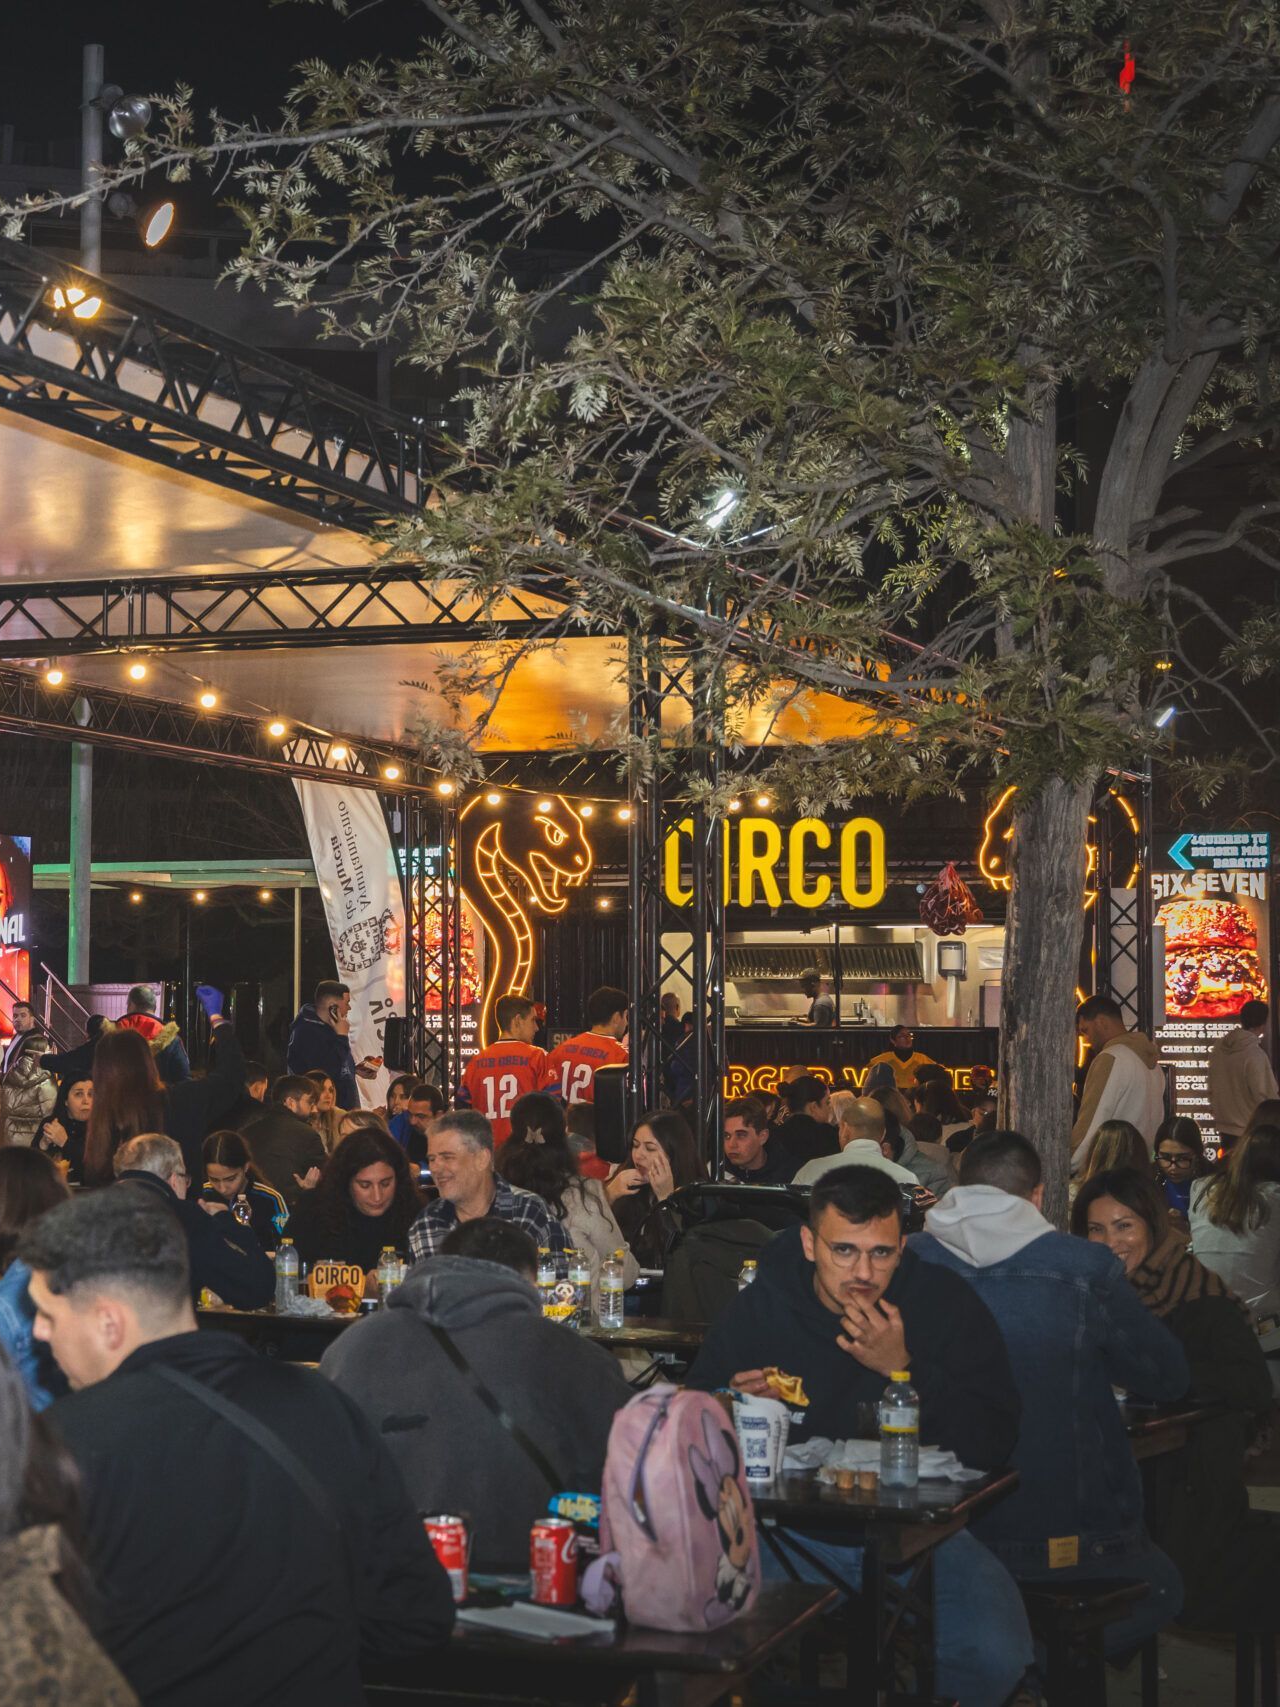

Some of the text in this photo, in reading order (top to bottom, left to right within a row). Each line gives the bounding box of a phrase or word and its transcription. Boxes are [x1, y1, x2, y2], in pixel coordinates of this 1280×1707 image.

[1151, 872, 1266, 900] SIX SEVEN
[483, 1074, 518, 1120] 12
[561, 1061, 593, 1104] 12
[315, 1266, 360, 1285] CIRCO
